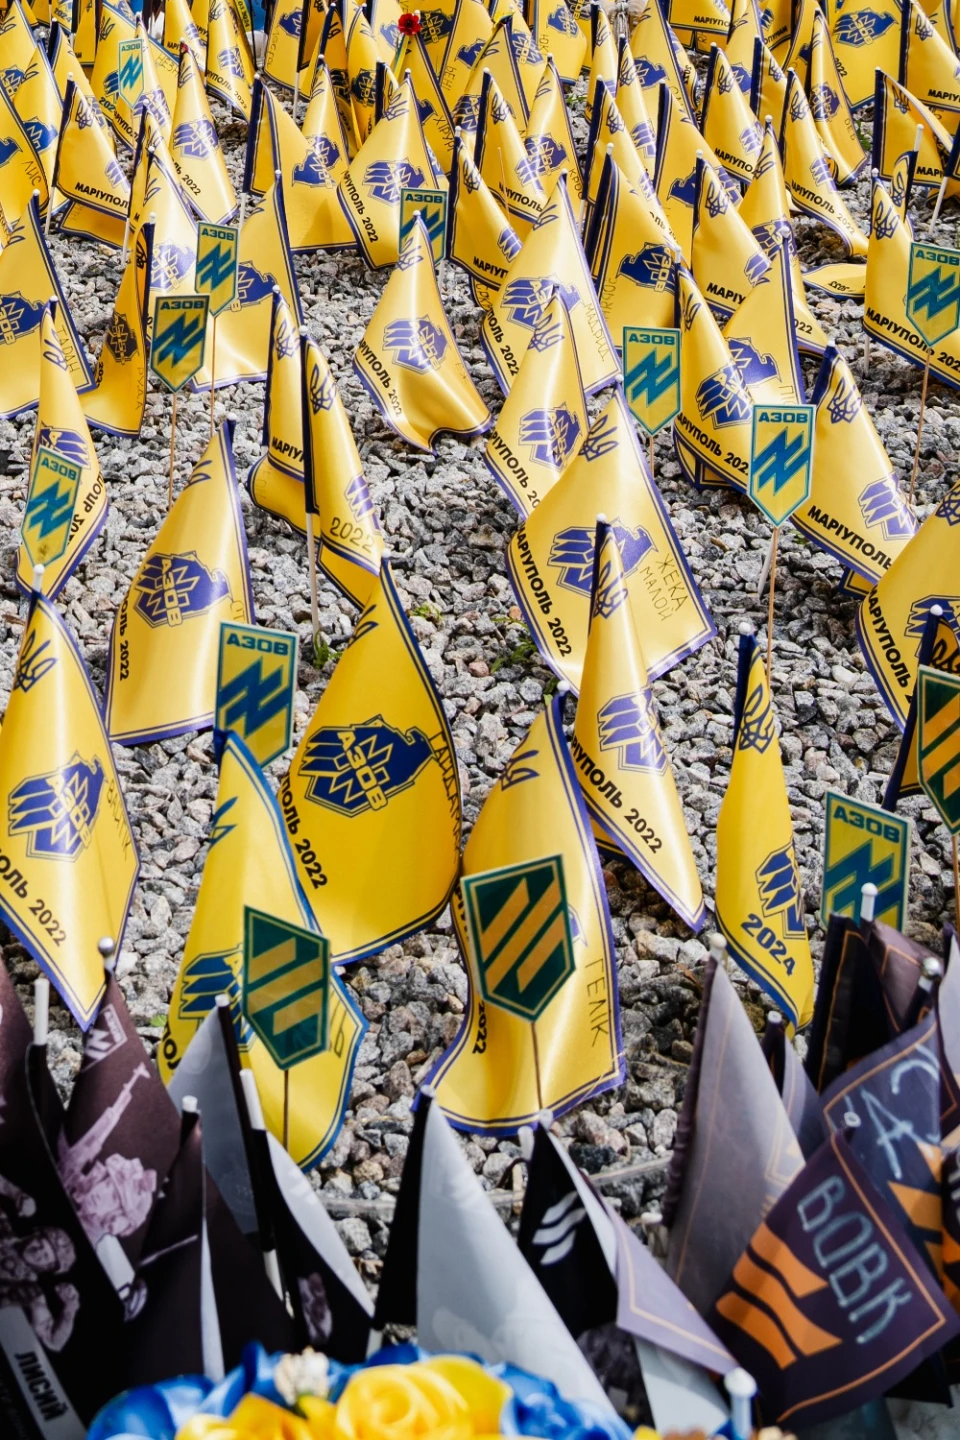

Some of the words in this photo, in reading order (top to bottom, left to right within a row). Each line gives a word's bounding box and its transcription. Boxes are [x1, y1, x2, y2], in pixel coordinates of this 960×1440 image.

[121, 43, 140, 52] АЗОВ
[404, 192, 444, 204] АЗОВ
[201, 228, 235, 241] АЗОВ
[361, 215, 380, 243] 2022
[836, 212, 856, 237] 2022
[915, 250, 960, 267] АЗОВ
[160, 299, 204, 310] АЗОВ
[629, 333, 675, 346] АЗОВ
[499, 350, 519, 376] 2022
[758, 411, 808, 424] АЗОВ
[42, 456, 77, 480] АЗОВ
[330, 519, 375, 556] 2022
[161, 557, 182, 628] АЗОВ
[640, 566, 671, 623] МАЛОЙ
[655, 553, 686, 613] ЖЕКА
[227, 635, 289, 656] АЗОВ
[548, 615, 572, 658] 2022
[120, 639, 130, 682] 2022
[337, 731, 386, 812] АЗОВ
[51, 772, 91, 849] АЗОВ
[624, 807, 663, 855] 2022
[833, 803, 901, 842] АЗОВ
[295, 838, 327, 891] 2022
[32, 898, 67, 948] 2022
[740, 913, 796, 977] 2024
[585, 957, 609, 1048] ГЕЛІК
[473, 1003, 487, 1056] 2022
[15, 1350, 69, 1423] ЛИСИЙ
